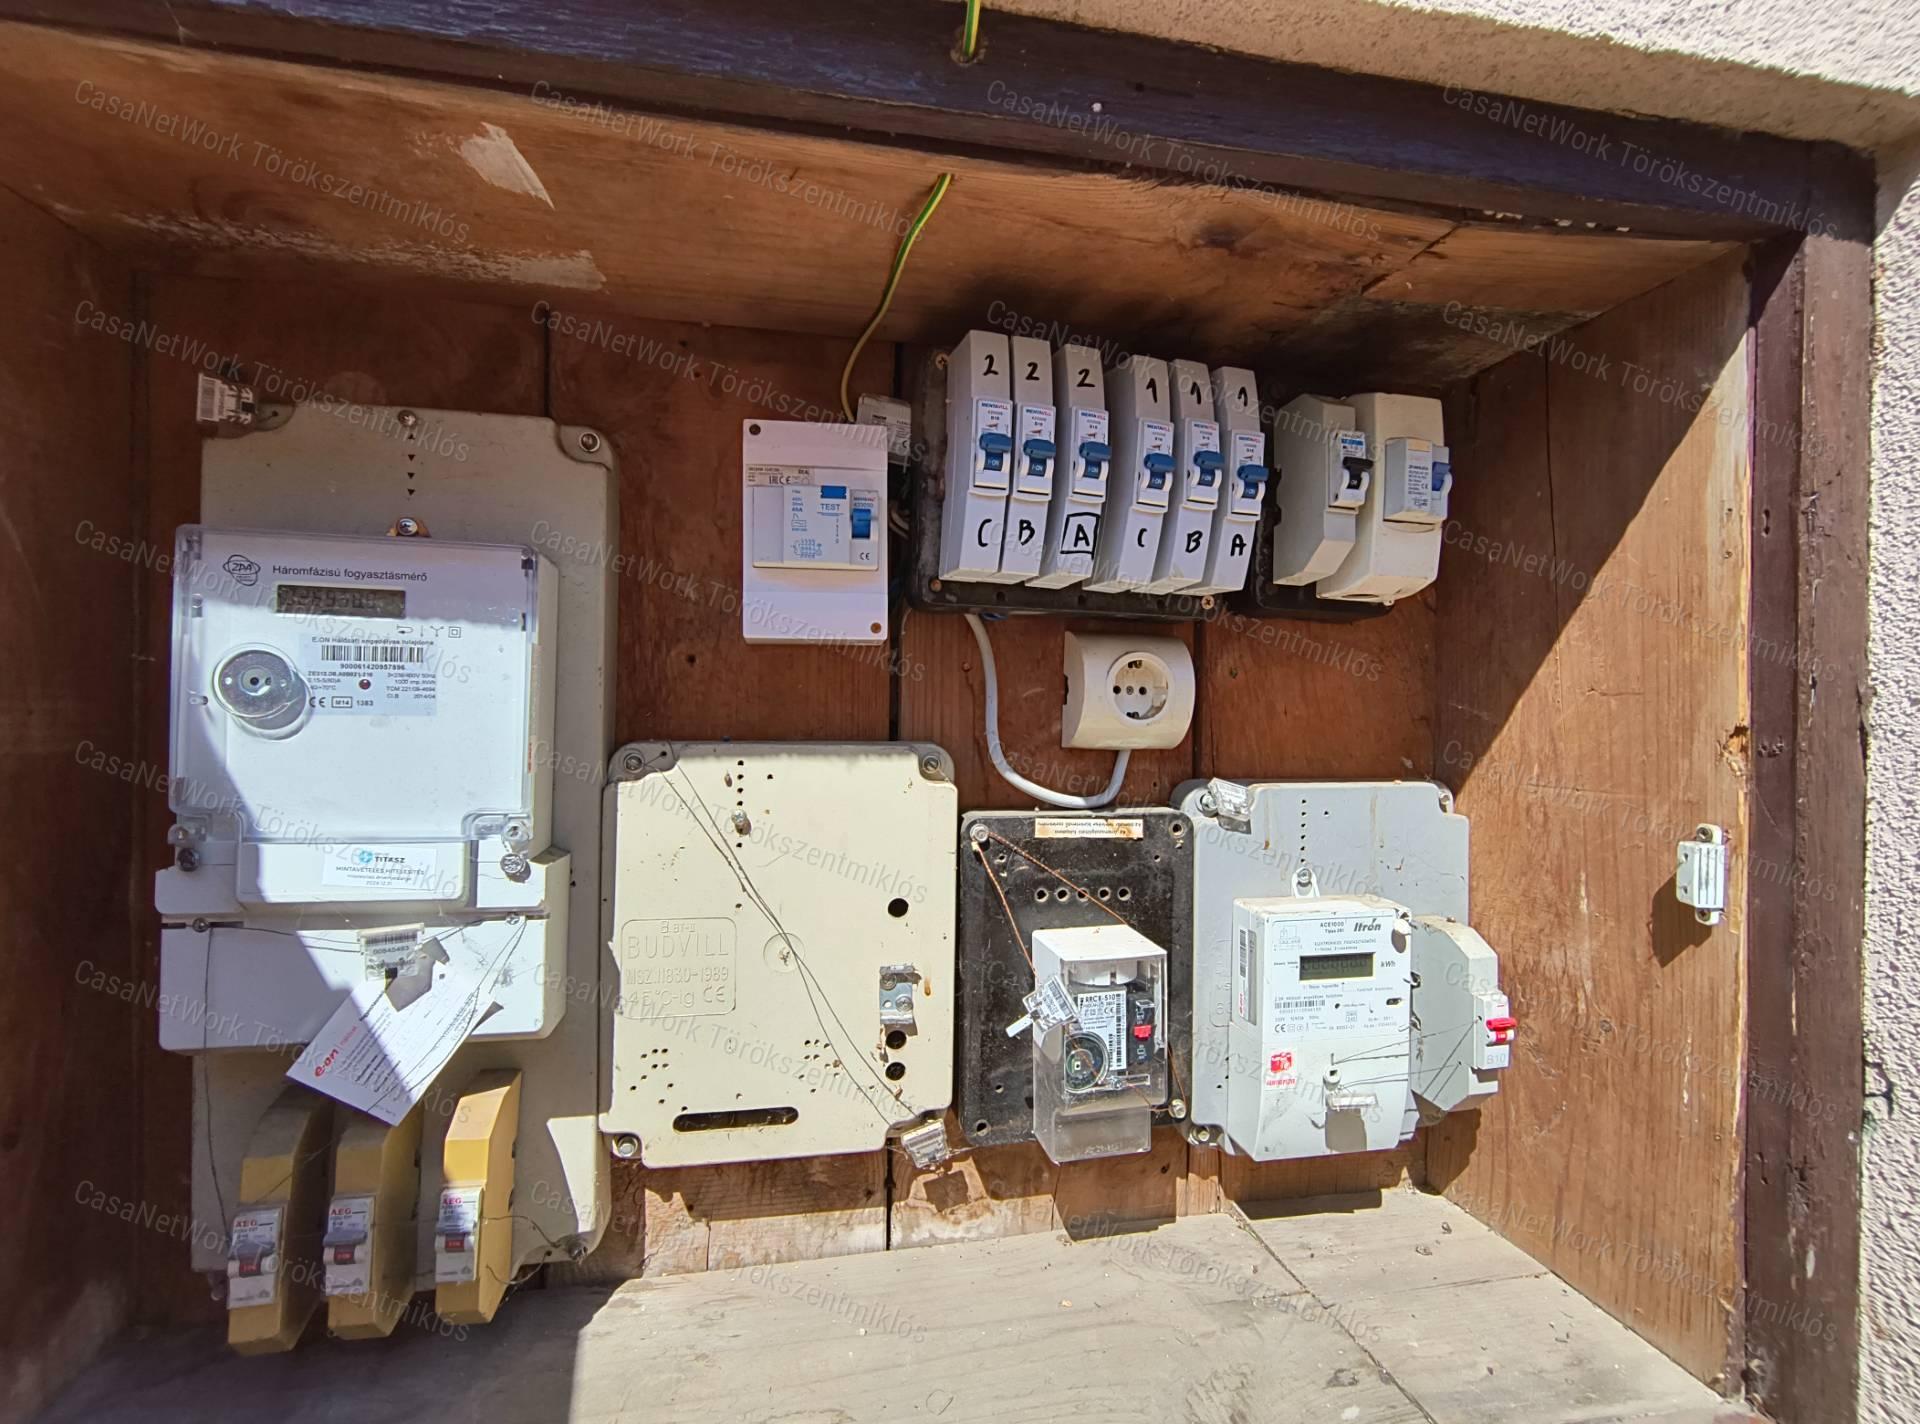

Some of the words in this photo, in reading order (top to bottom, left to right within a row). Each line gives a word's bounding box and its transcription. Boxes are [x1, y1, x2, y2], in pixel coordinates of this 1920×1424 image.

[984, 354, 998, 376] 2
[1026, 362, 1040, 381] 2
[1078, 368, 1095, 388] 2
[978, 518, 992, 547] C
[1018, 520, 1035, 542] B
[1073, 524, 1090, 548] A
[1138, 528, 1148, 548] C
[1186, 531, 1203, 552] B
[1231, 534, 1246, 556] A
[860, 552, 870, 560] CE
[272, 565, 340, 577] Háromfázisú
[344, 569, 428, 582] fogyasztásmérő
[1354, 918, 1382, 932] Itron
[628, 934, 728, 959] BUDVILL
[1274, 1024, 1286, 1033] CE
[331, 1207, 352, 1216] AEG
[443, 1198, 462, 1206] AEG
[236, 1219, 256, 1228] AEG
